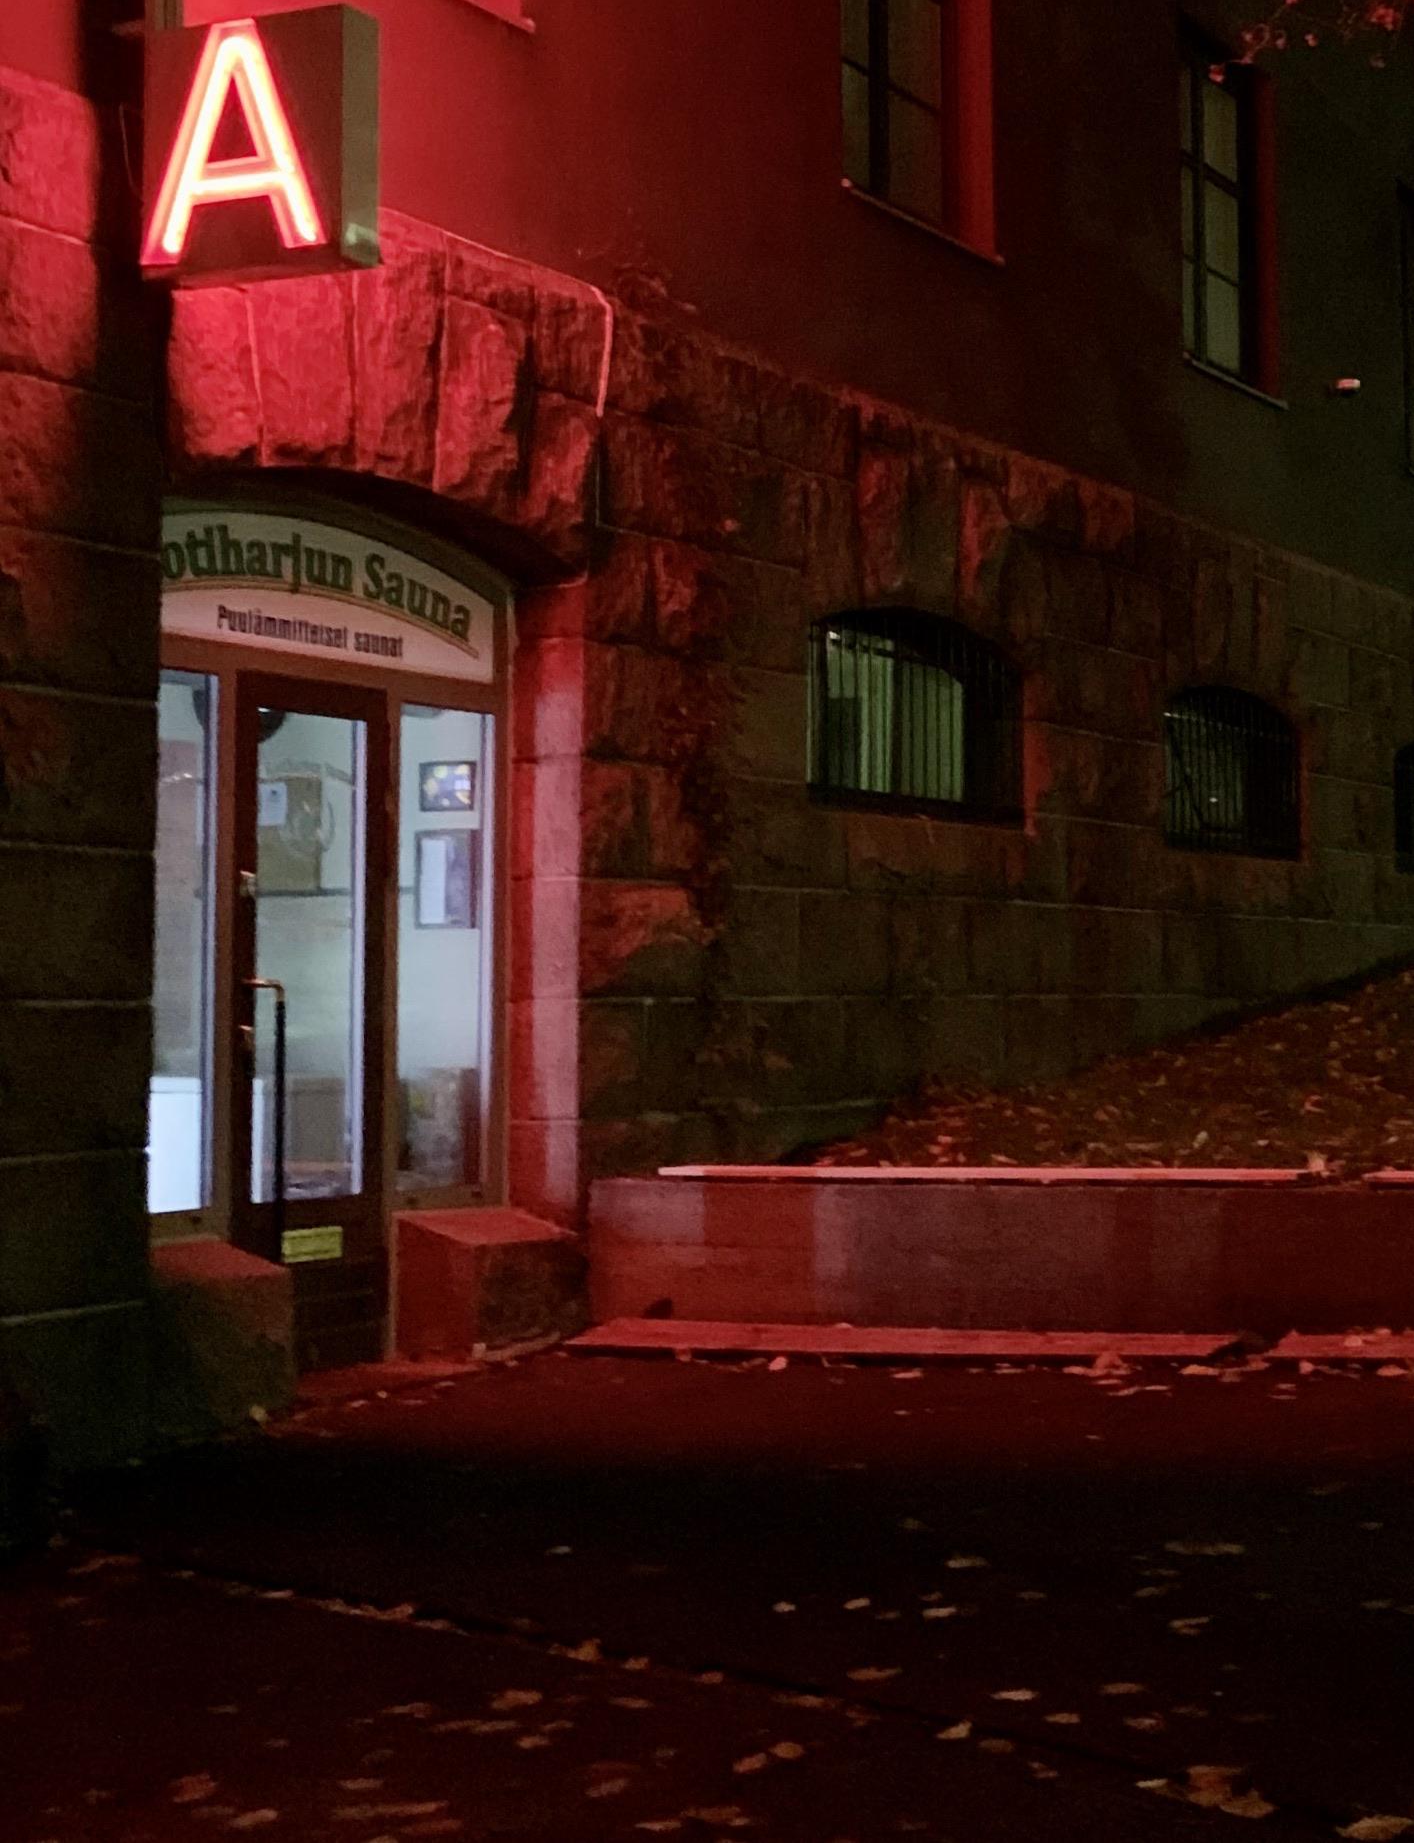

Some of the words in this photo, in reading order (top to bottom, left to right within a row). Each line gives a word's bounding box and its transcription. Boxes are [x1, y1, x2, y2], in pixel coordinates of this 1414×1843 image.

[161, 523, 353, 592] otiharjun
[362, 553, 471, 642] Sauna
[353, 630, 404, 658] saunat
